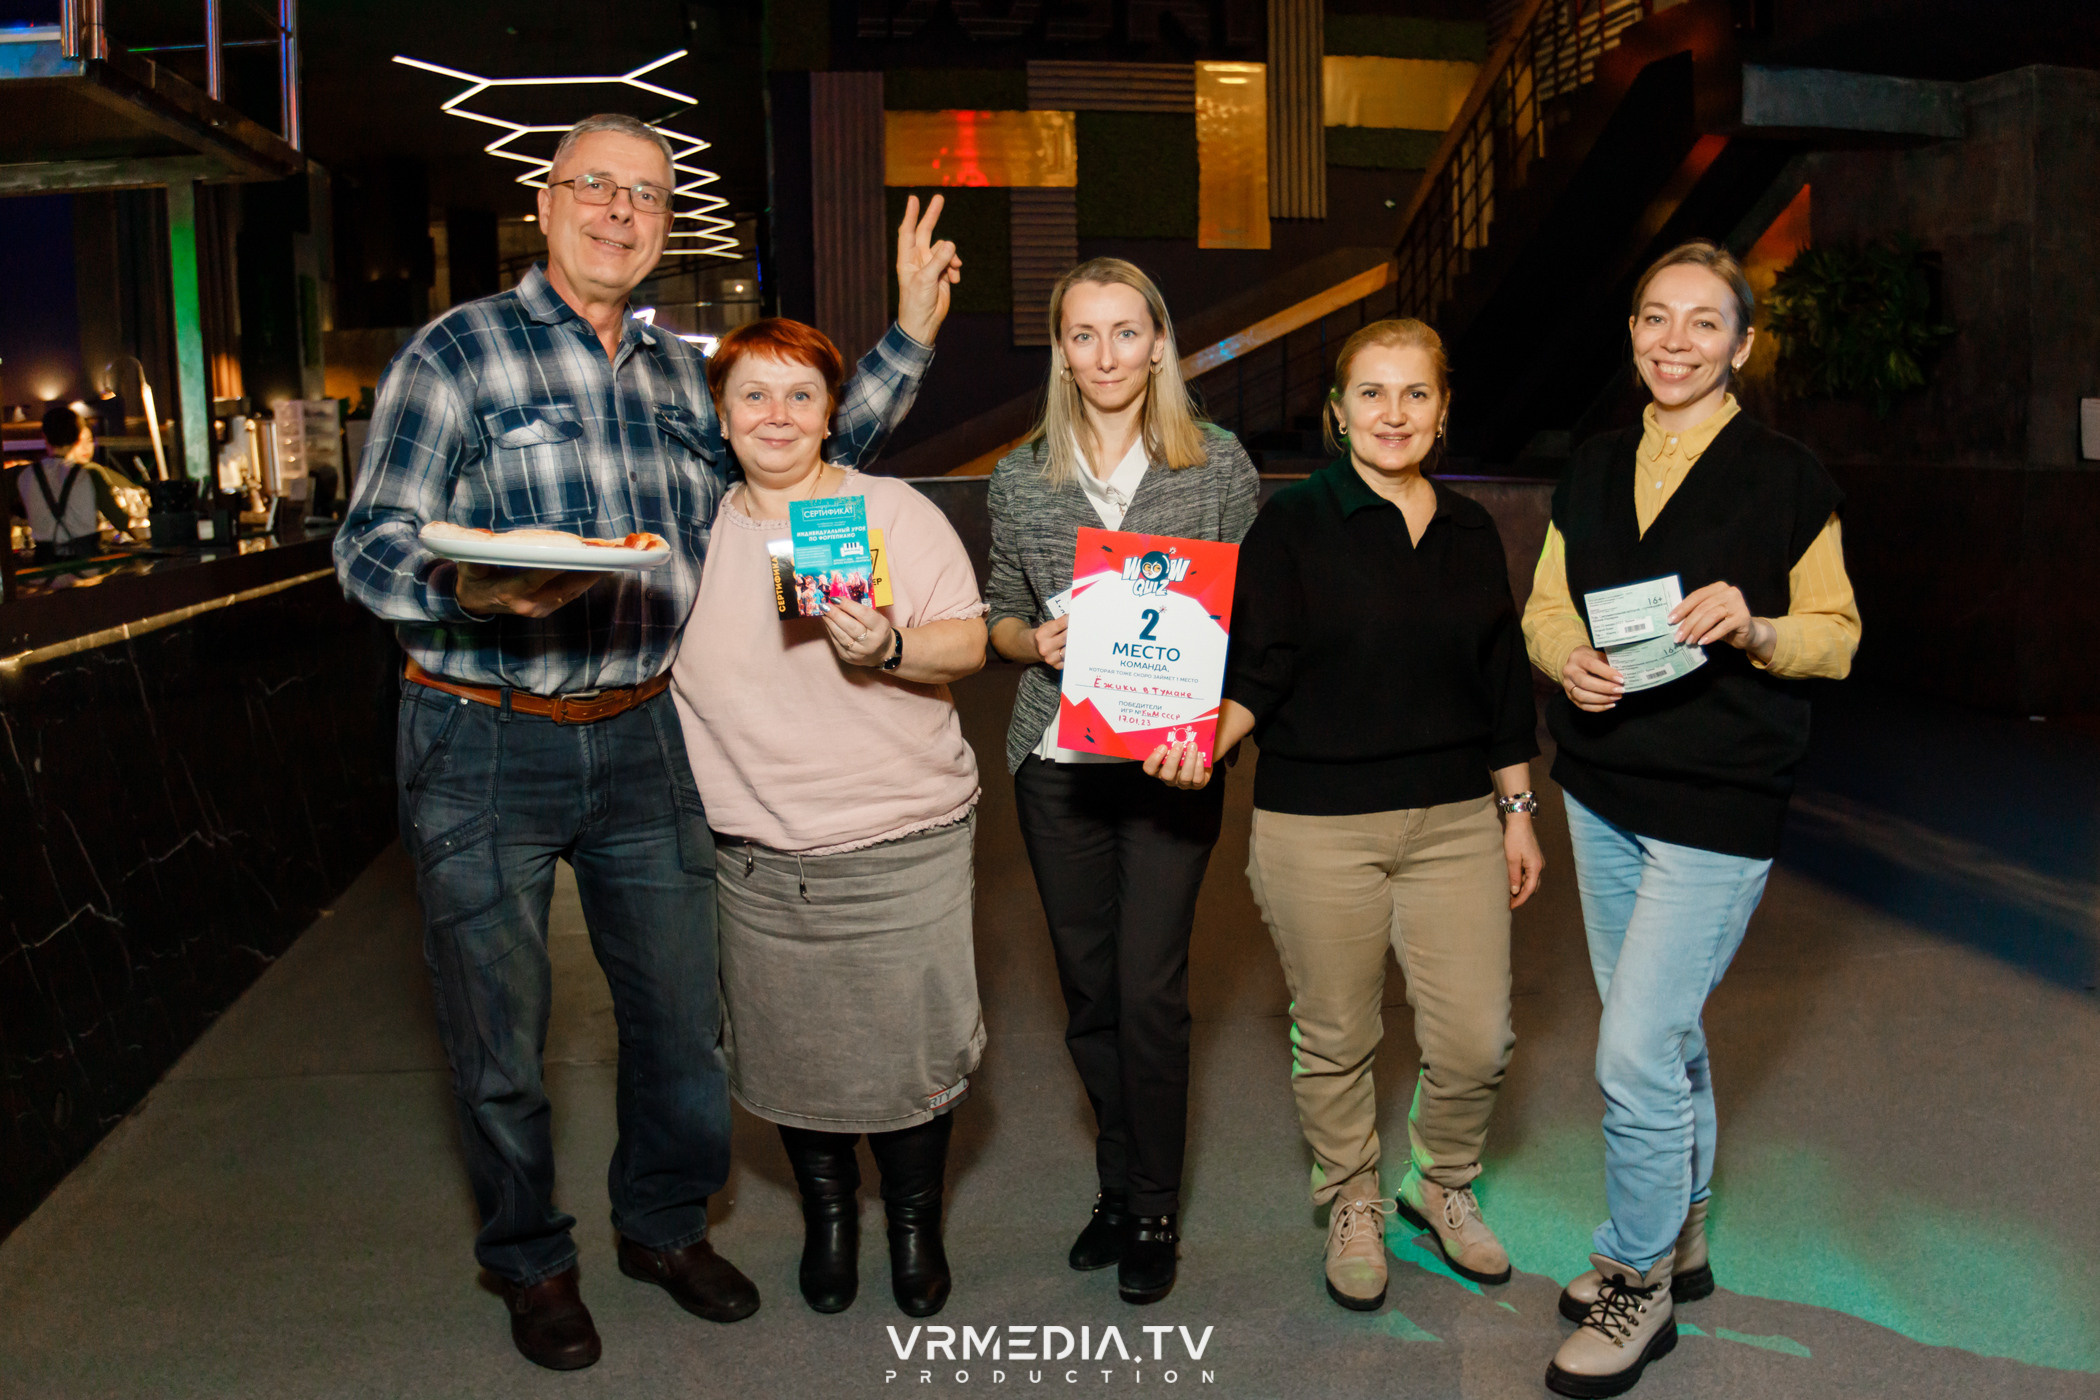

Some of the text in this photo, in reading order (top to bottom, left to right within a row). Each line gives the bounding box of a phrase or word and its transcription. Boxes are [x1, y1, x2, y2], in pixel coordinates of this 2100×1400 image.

[804, 506, 853, 518] СЕРТИФИКАТ
[797, 528, 850, 537] ИНДИВИДУАЛЬНЫЙ
[1122, 551, 1191, 581] WOW
[771, 555, 786, 613] СЕРТИФИКА
[1133, 580, 1169, 596] QUIZ
[1647, 596, 1662, 606] 16+
[1139, 609, 1159, 641] 2
[1112, 642, 1181, 662] МЕСТО
[1093, 675, 1137, 692] Ёжики
[1143, 686, 1149, 694] в
[1118, 700, 1162, 710] ПОБЕДИТЕЛИ
